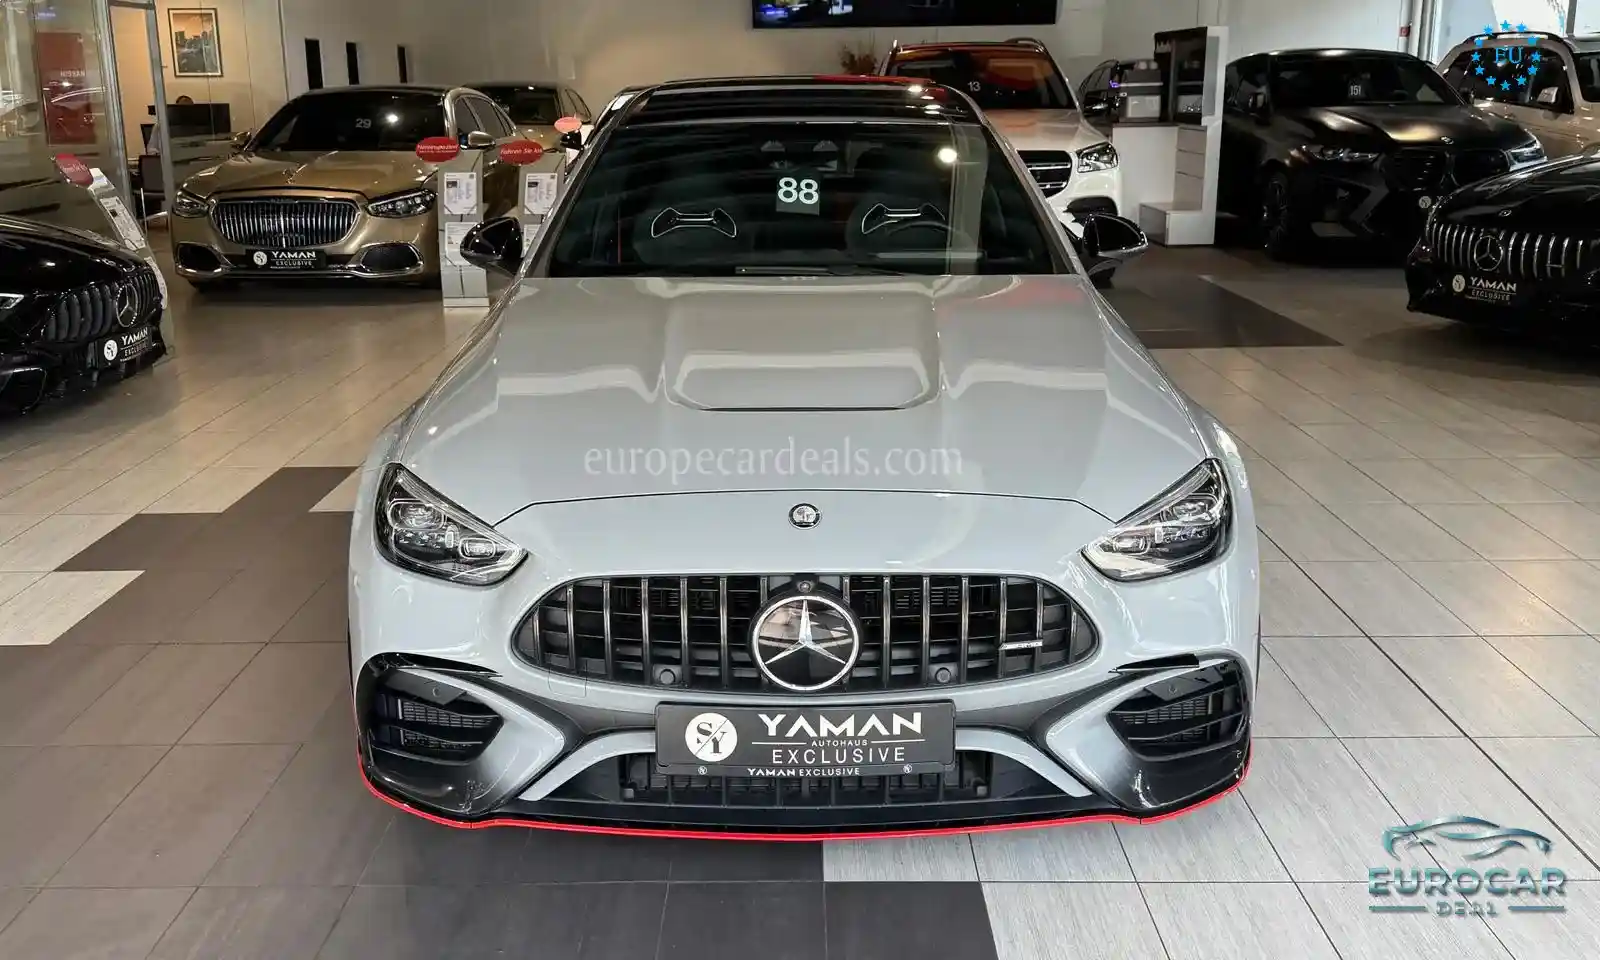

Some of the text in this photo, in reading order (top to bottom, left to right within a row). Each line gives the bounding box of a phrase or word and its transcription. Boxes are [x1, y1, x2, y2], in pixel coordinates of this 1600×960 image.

[967, 80, 981, 92] 13
[355, 118, 372, 129] 29
[777, 176, 819, 205] 88
[271, 251, 317, 259] YAMAN
[1470, 276, 1517, 292] YAMAN
[121, 326, 148, 346] YAMAN
[757, 711, 922, 738] YAMAN
[811, 739, 868, 747] AUTOHAUS
[772, 746, 905, 764] EXCLUSIVE
[747, 767, 860, 777] YAMAN EXCLUSIVE
